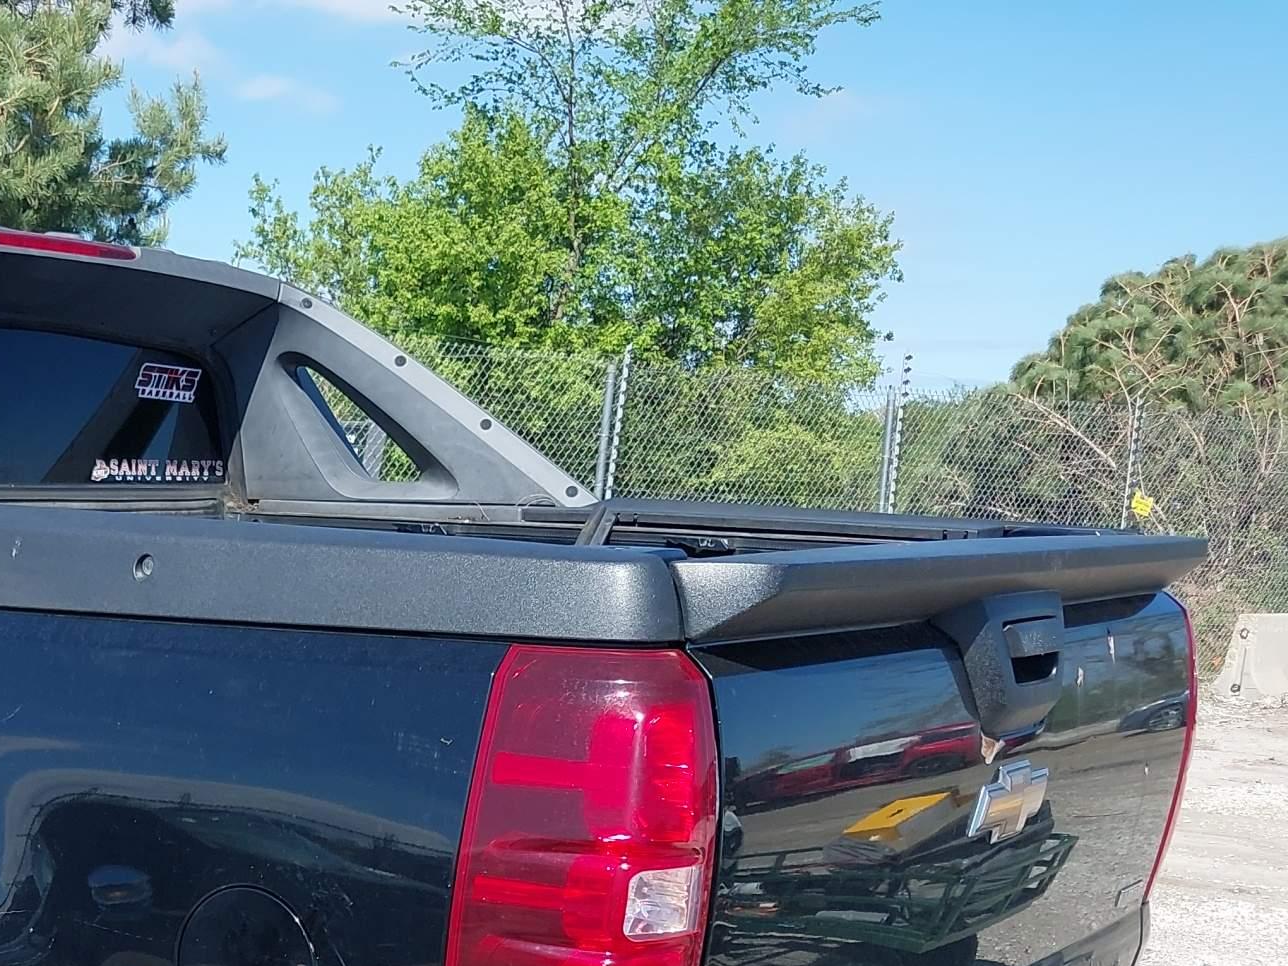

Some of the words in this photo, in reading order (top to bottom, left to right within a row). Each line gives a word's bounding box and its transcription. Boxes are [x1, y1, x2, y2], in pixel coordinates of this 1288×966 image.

[140, 388, 194, 401] BASEBALL
[110, 458, 159, 476] SAINT
[165, 459, 223, 477] MARY'S
